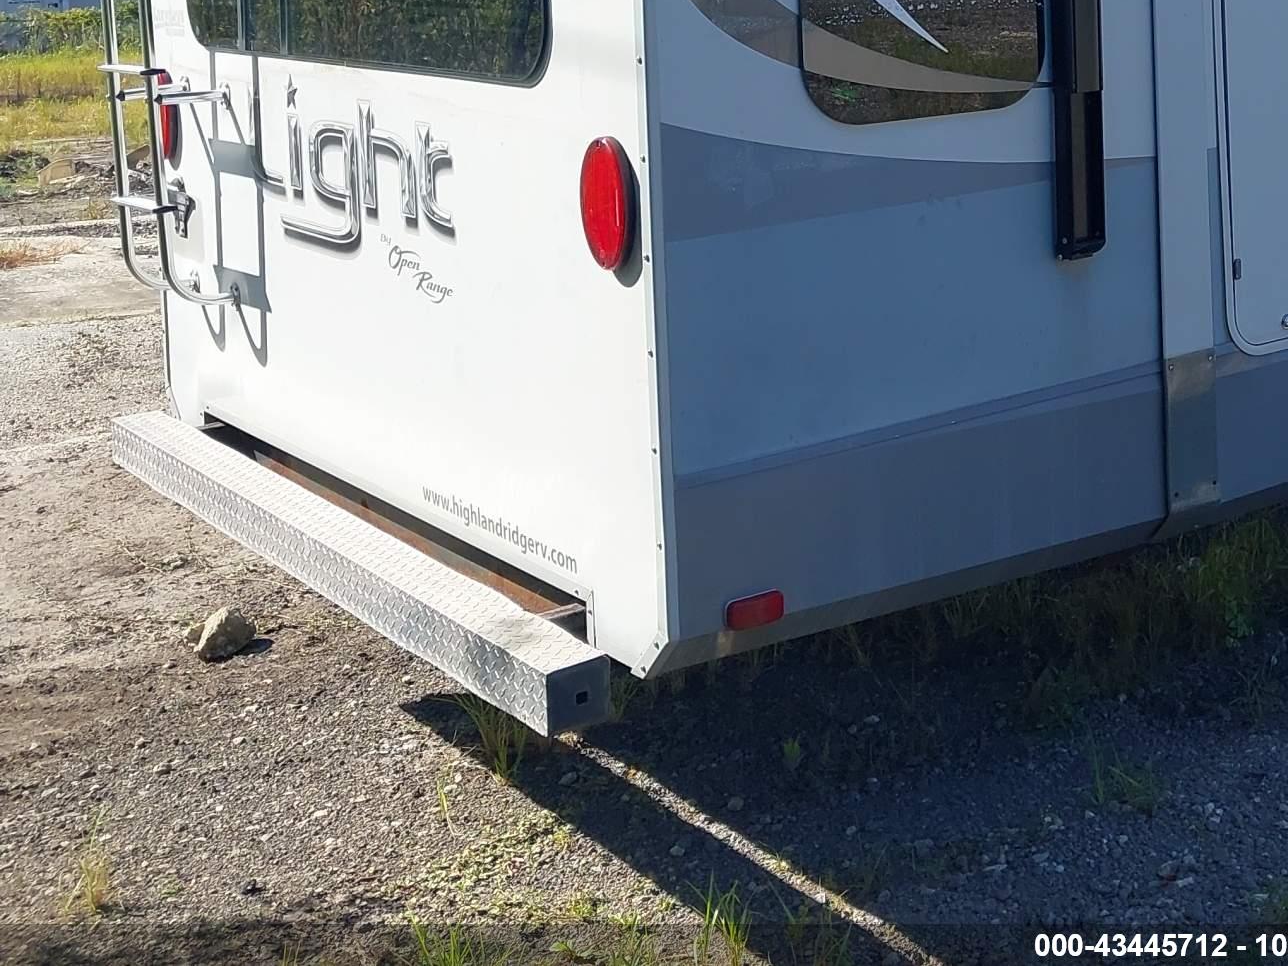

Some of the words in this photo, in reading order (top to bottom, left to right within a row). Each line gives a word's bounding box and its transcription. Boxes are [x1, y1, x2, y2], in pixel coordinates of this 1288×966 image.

[388, 245, 421, 276] Open
[412, 271, 454, 304] Range
[422, 485, 578, 574] www.highlandridgerv.com
